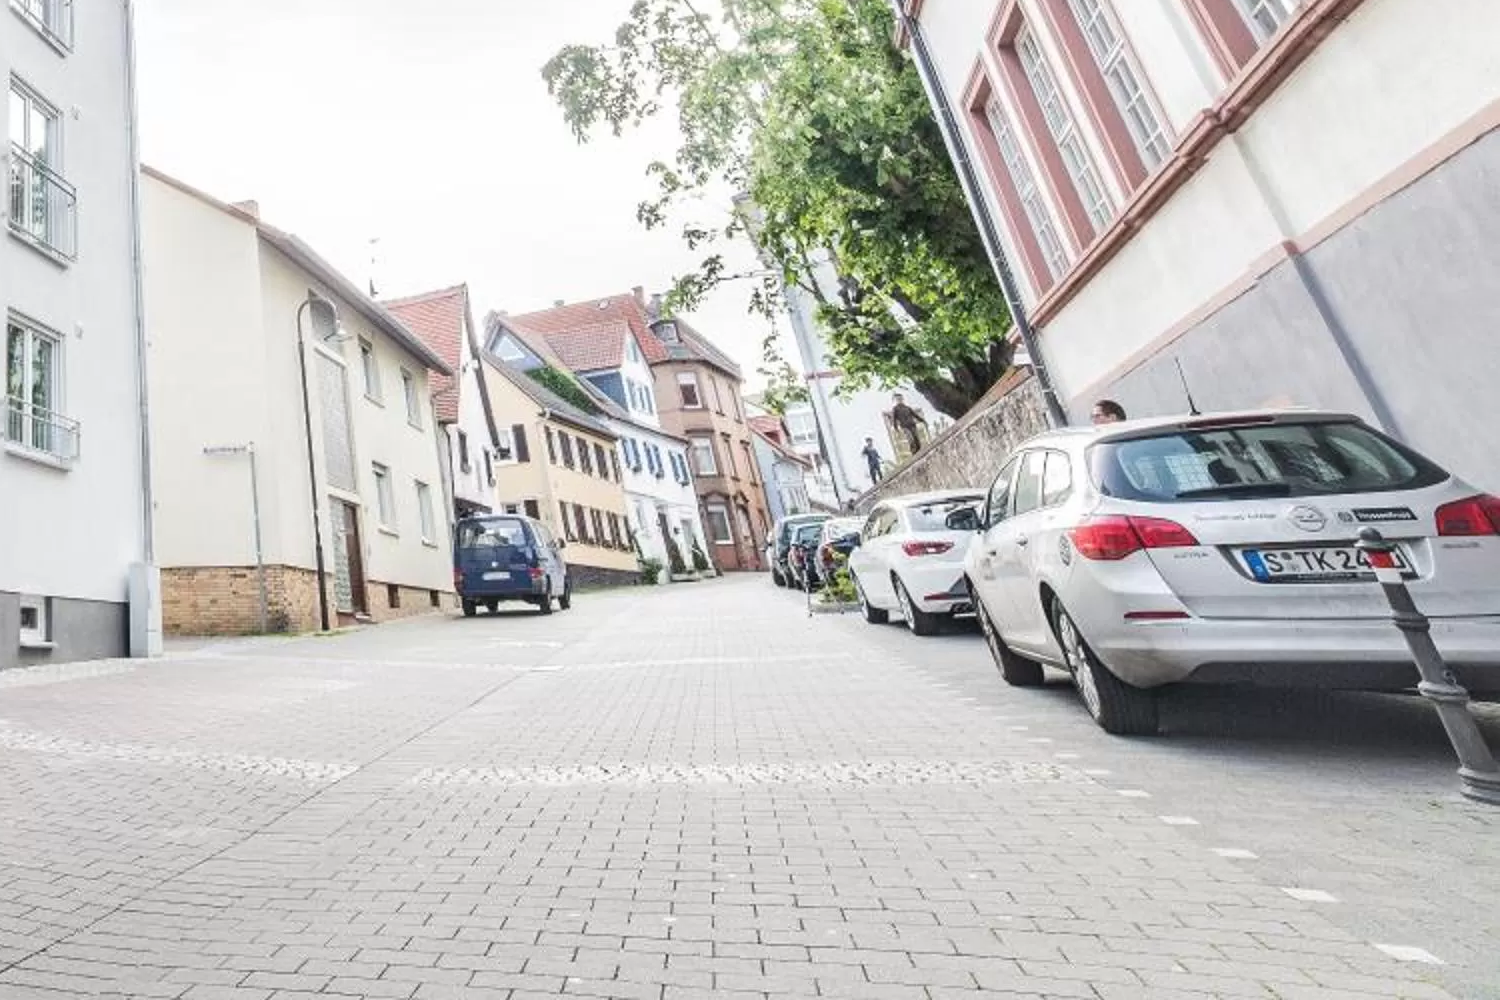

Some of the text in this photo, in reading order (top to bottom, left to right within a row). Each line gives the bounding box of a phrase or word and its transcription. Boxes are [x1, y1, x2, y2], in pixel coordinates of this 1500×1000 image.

[1264, 552, 1283, 573] S
[1295, 551, 1335, 571] TK
[1336, 550, 1378, 569] 24
